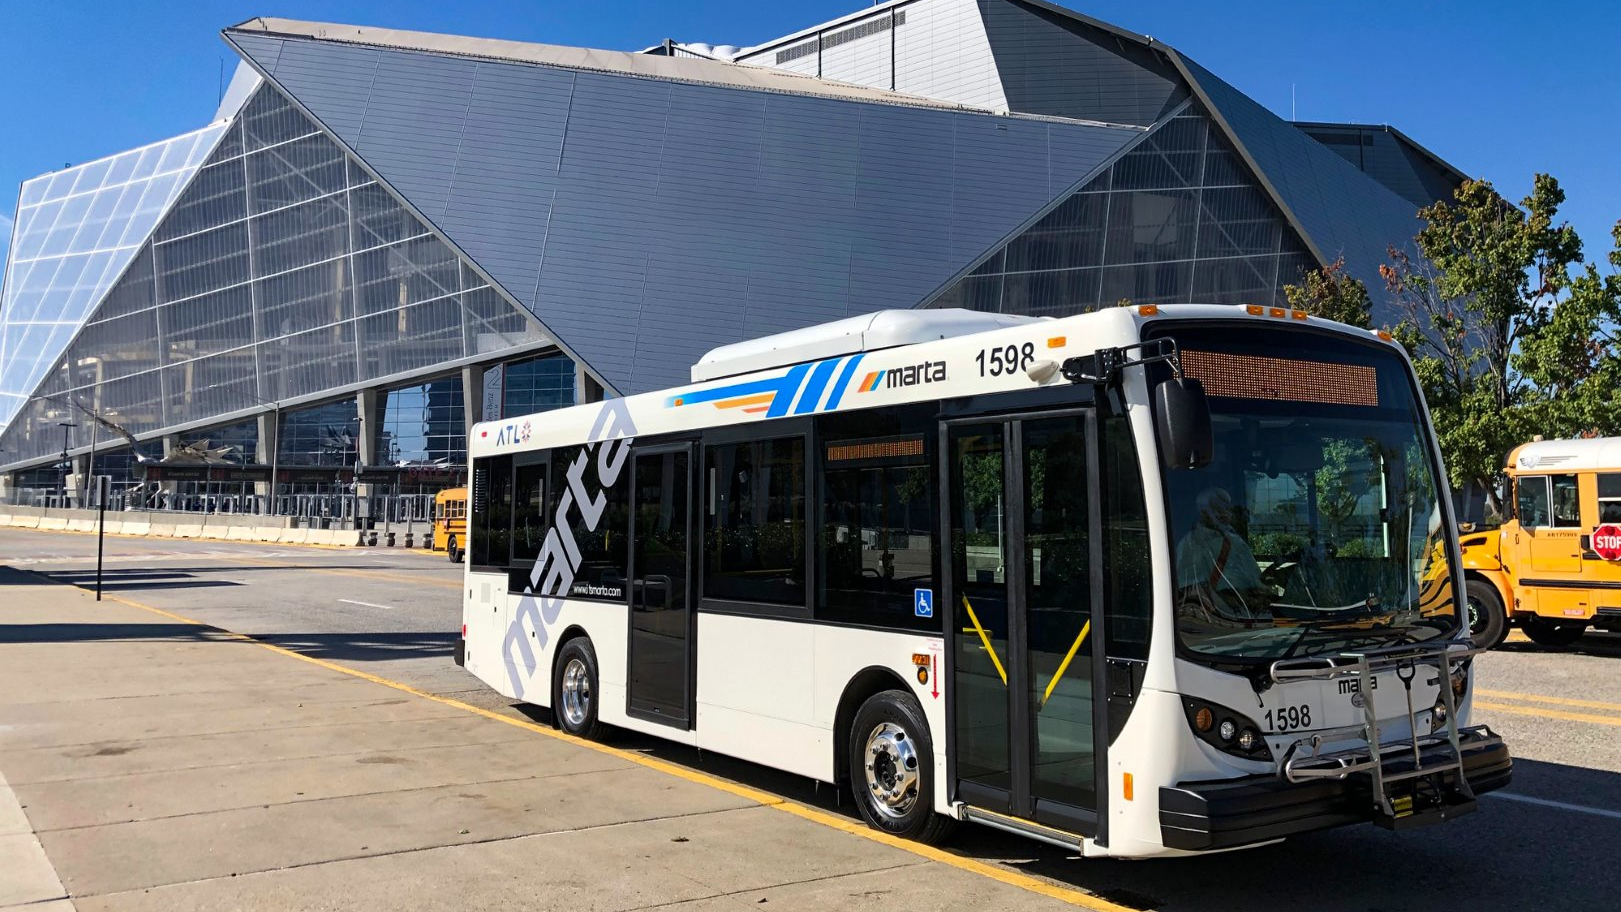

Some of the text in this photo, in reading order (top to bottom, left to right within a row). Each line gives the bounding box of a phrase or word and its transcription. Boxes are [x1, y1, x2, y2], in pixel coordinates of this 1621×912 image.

[976, 342, 1035, 378] 1598
[887, 361, 946, 389] marta
[496, 424, 521, 447] ATL
[501, 397, 638, 701] marta
[1264, 704, 1312, 731] 1598
